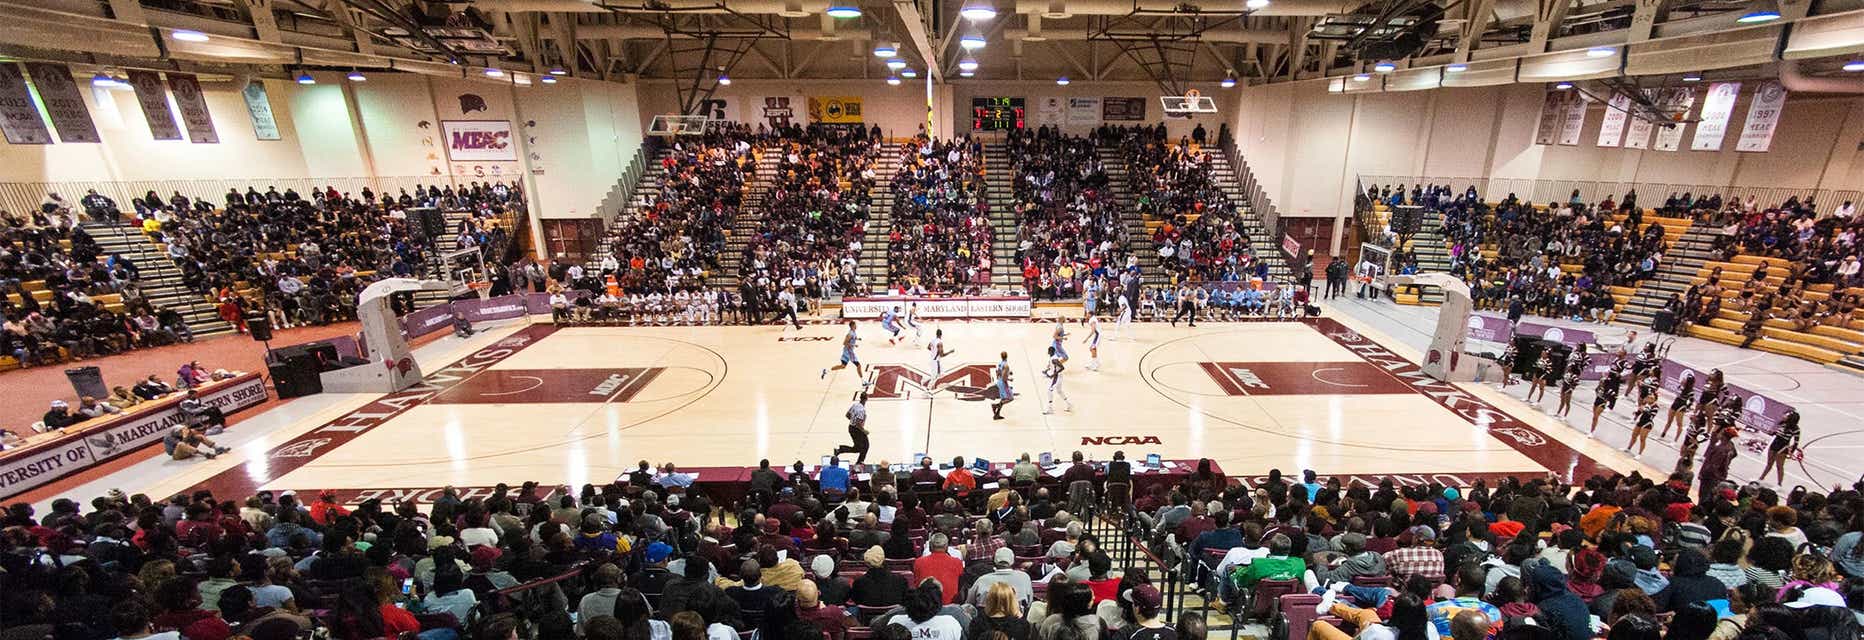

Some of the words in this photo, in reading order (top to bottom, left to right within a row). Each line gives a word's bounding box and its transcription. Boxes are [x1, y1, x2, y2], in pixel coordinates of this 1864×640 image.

[1754, 109, 1775, 119] 1997
[452, 130, 509, 150] MEAC
[844, 304, 890, 314] UNIVERSITY
[923, 304, 968, 313] MARYLAND
[970, 304, 1003, 313] EASTERN
[1005, 304, 1029, 313] SHORE
[315, 348, 513, 434] HAWKS
[1345, 343, 1513, 424] HAWKS
[66, 446, 87, 462] OF
[117, 412, 186, 445] MARYLAND
[232, 383, 264, 402] SHORE
[1081, 436, 1162, 445] NCAA
